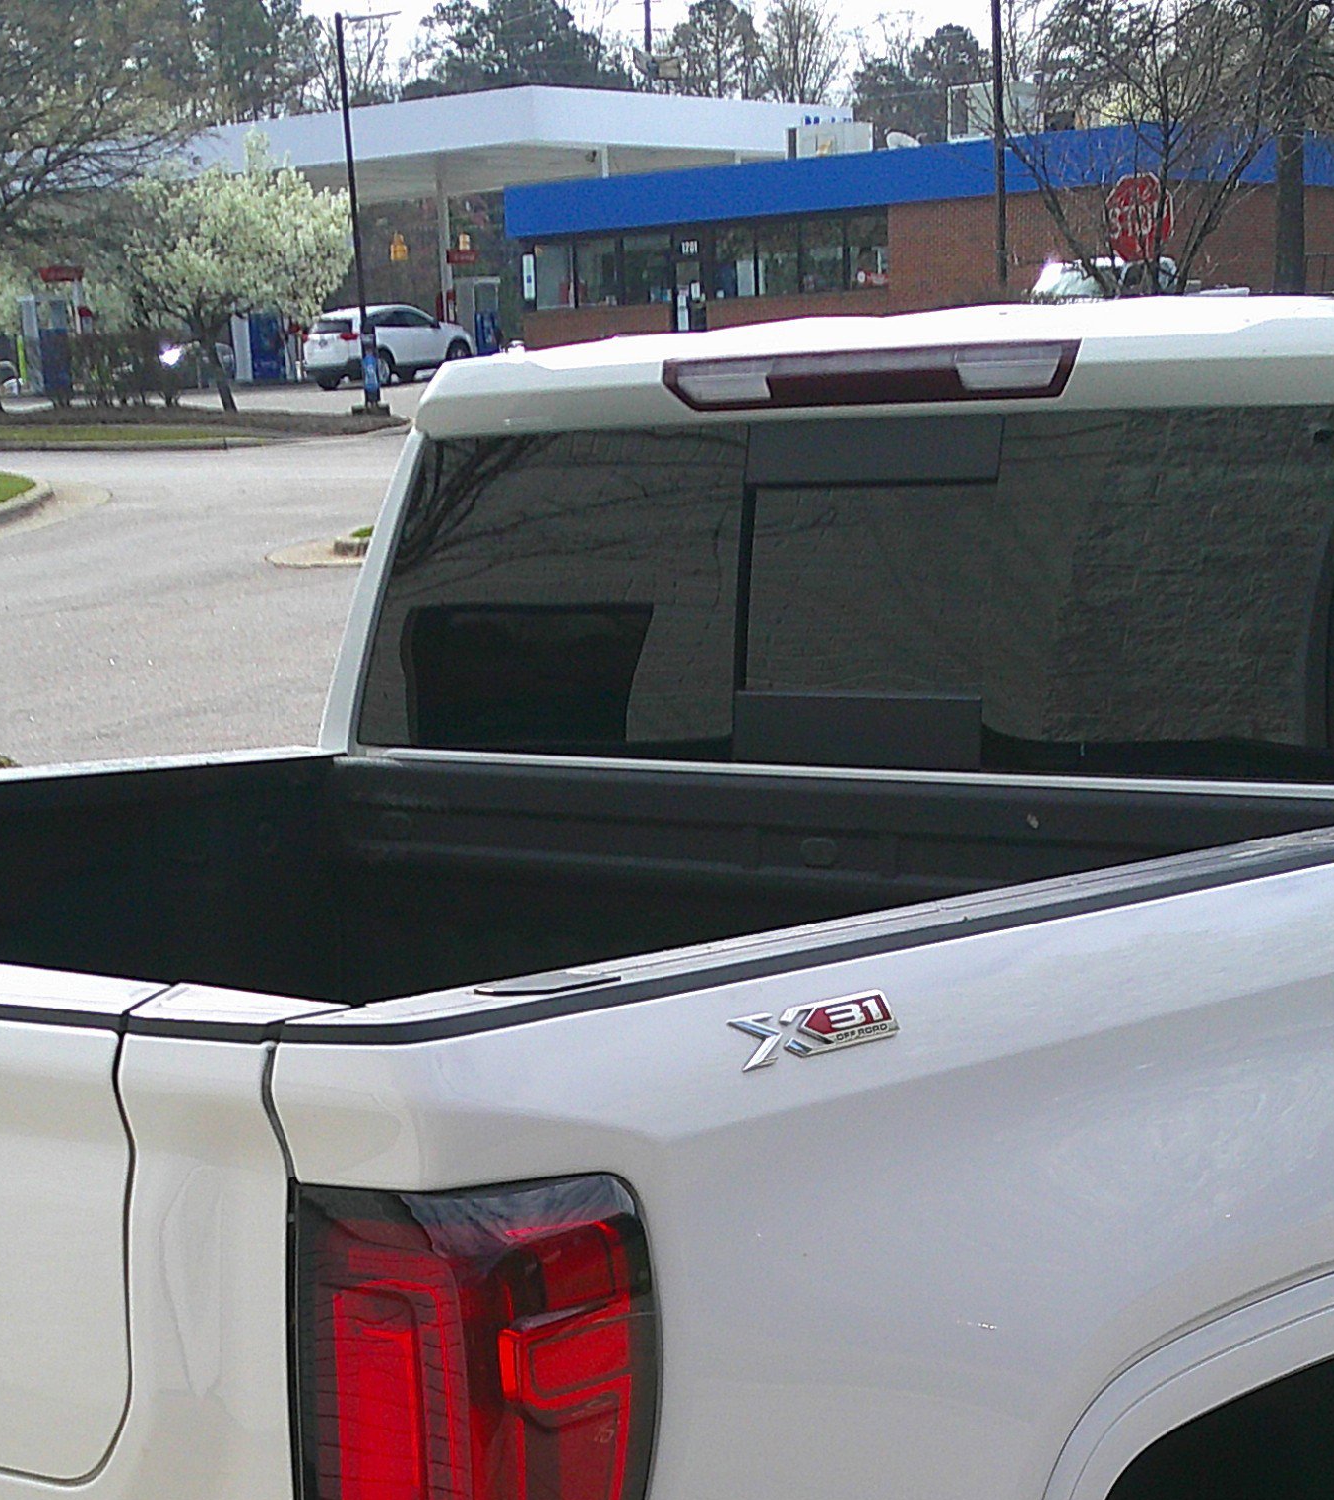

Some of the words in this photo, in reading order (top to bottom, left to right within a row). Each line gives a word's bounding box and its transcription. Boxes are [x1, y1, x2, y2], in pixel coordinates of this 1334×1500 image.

[1108, 200, 1168, 239] STO
[836, 1029, 857, 1041] OFF
[858, 1023, 888, 1036] ROAD
